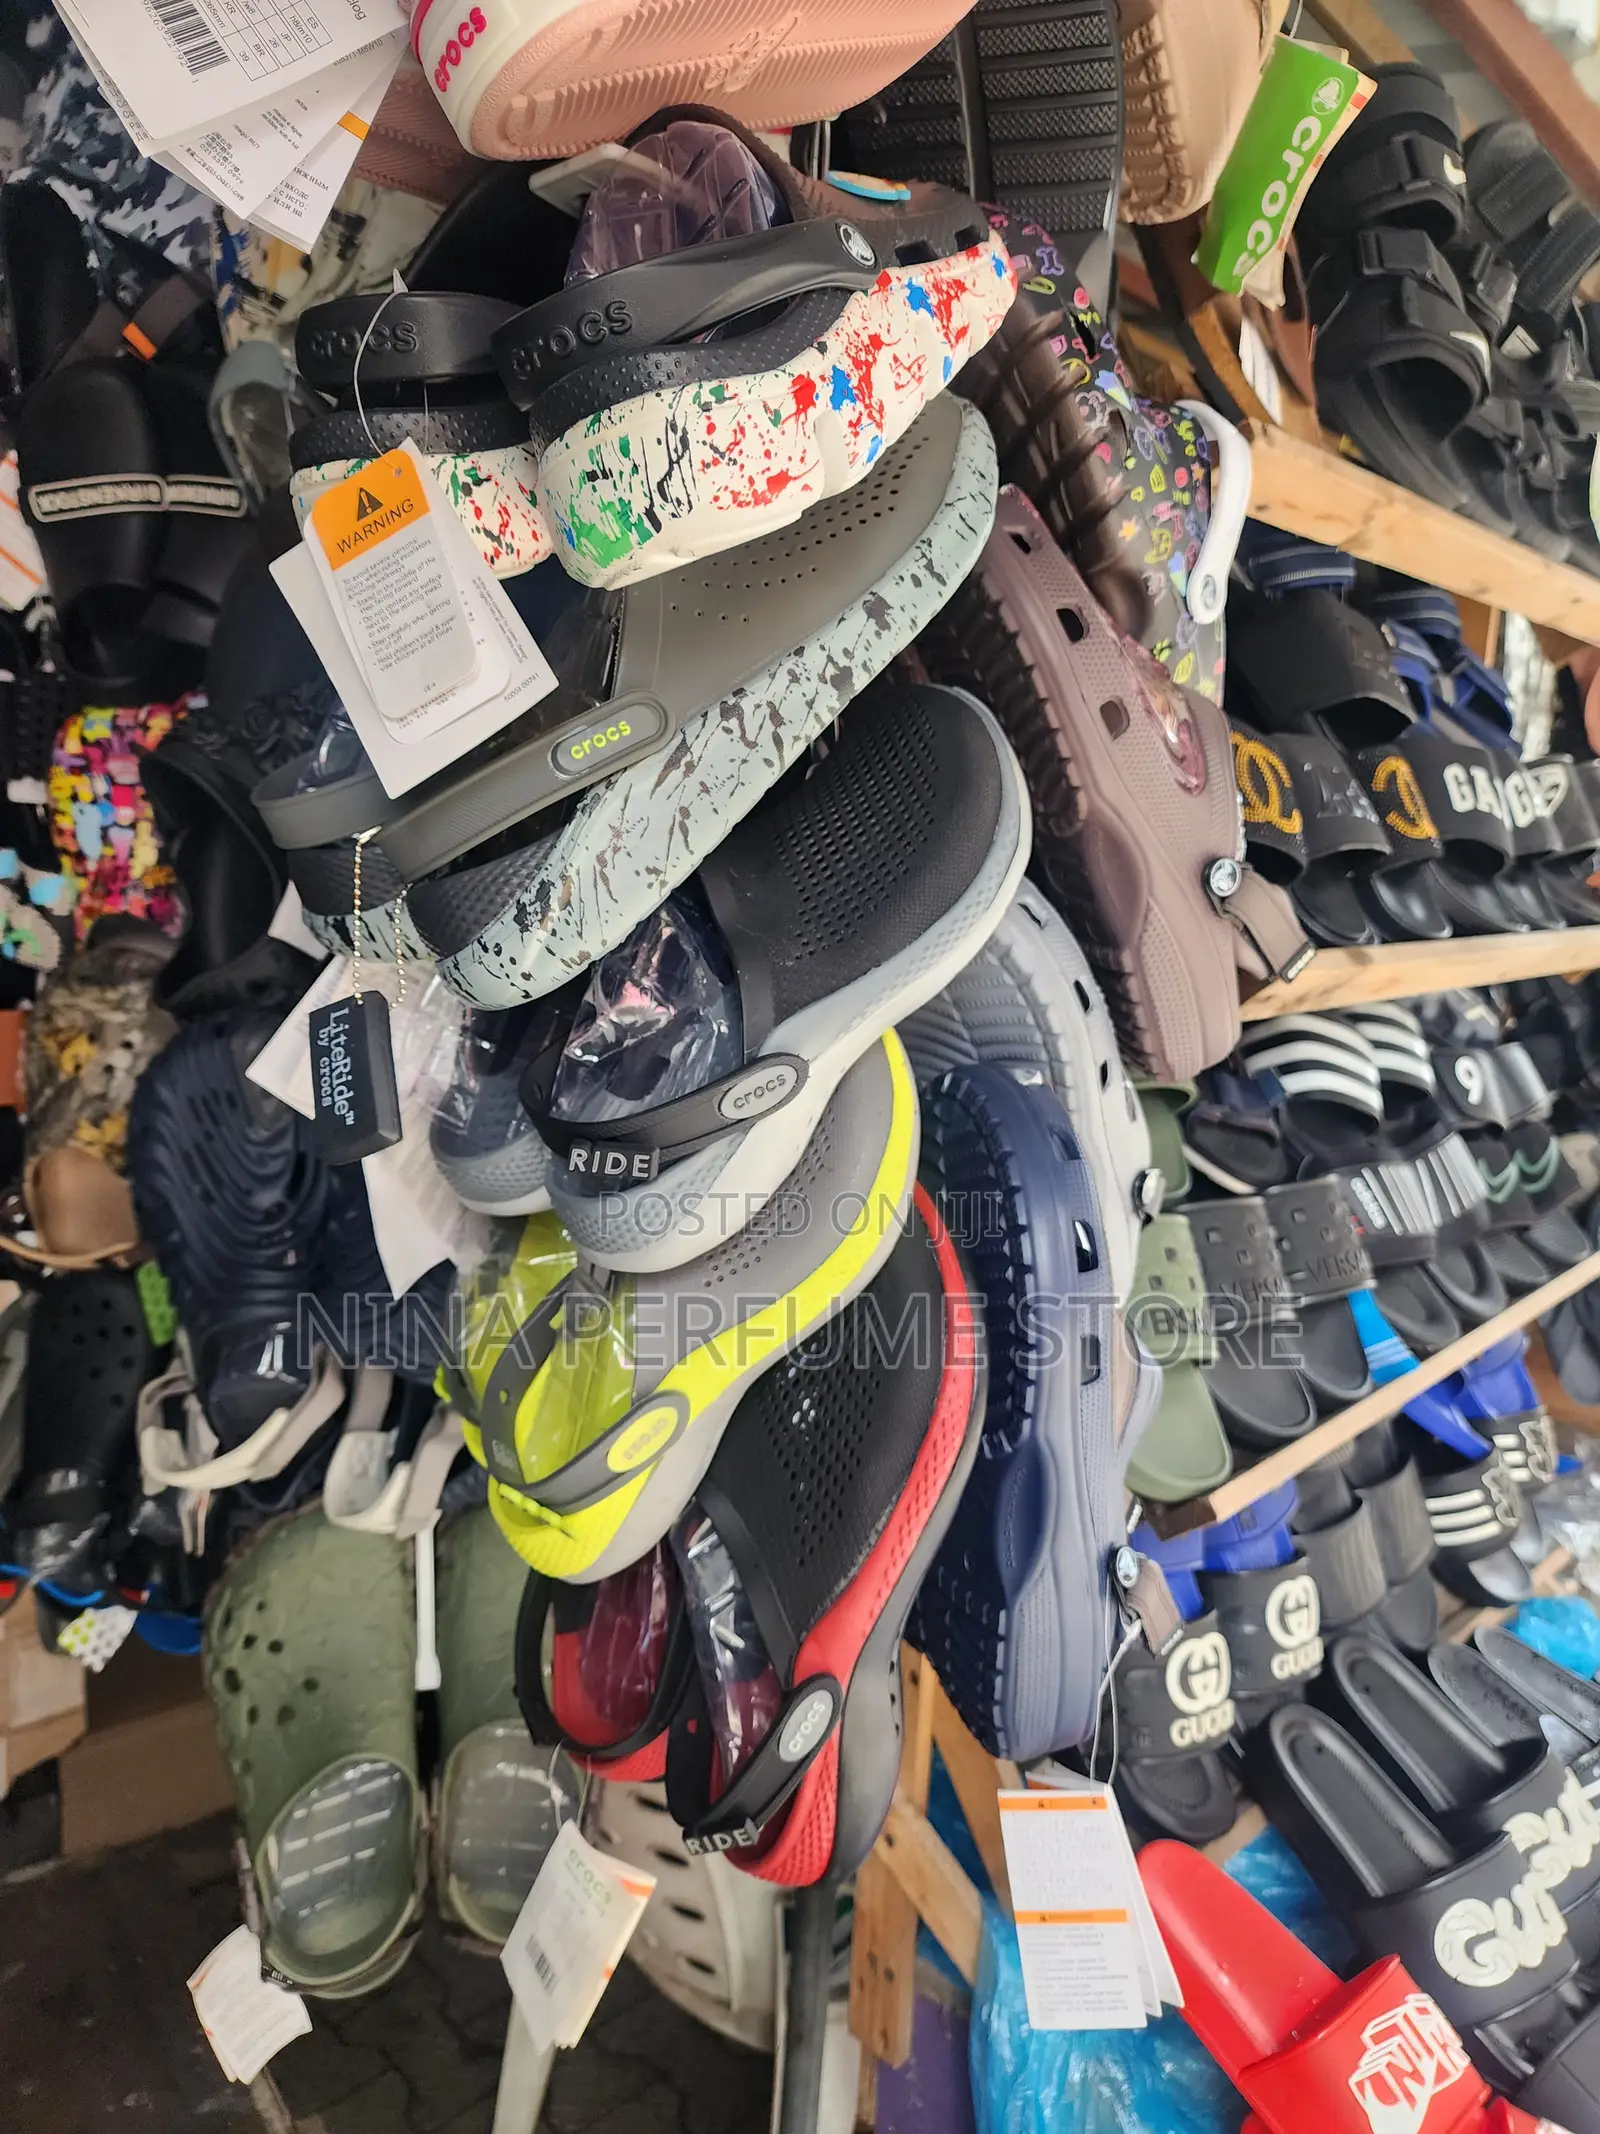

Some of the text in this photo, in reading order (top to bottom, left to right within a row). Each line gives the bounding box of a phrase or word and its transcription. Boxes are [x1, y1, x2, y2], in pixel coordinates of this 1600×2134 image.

[224, 2, 236, 14] KR
[306, 16, 318, 29] ES
[268, 38, 279, 49] 26
[280, 31, 291, 42] JP
[289, 15, 312, 44] h8/m10
[239, 51, 250, 62] 39
[253, 43, 265, 57] BR
[434, 7, 487, 92] crocs
[337, 499, 414, 554] WARNING
[570, 720, 631, 759] crocs
[307, 1027, 331, 1047] by
[309, 1056, 333, 1108] crocs
[733, 1073, 788, 1110] crocs
[568, 1148, 651, 1179] RIDE
[787, 1701, 827, 1754] crocs
[685, 1827, 752, 1857] RIDE
